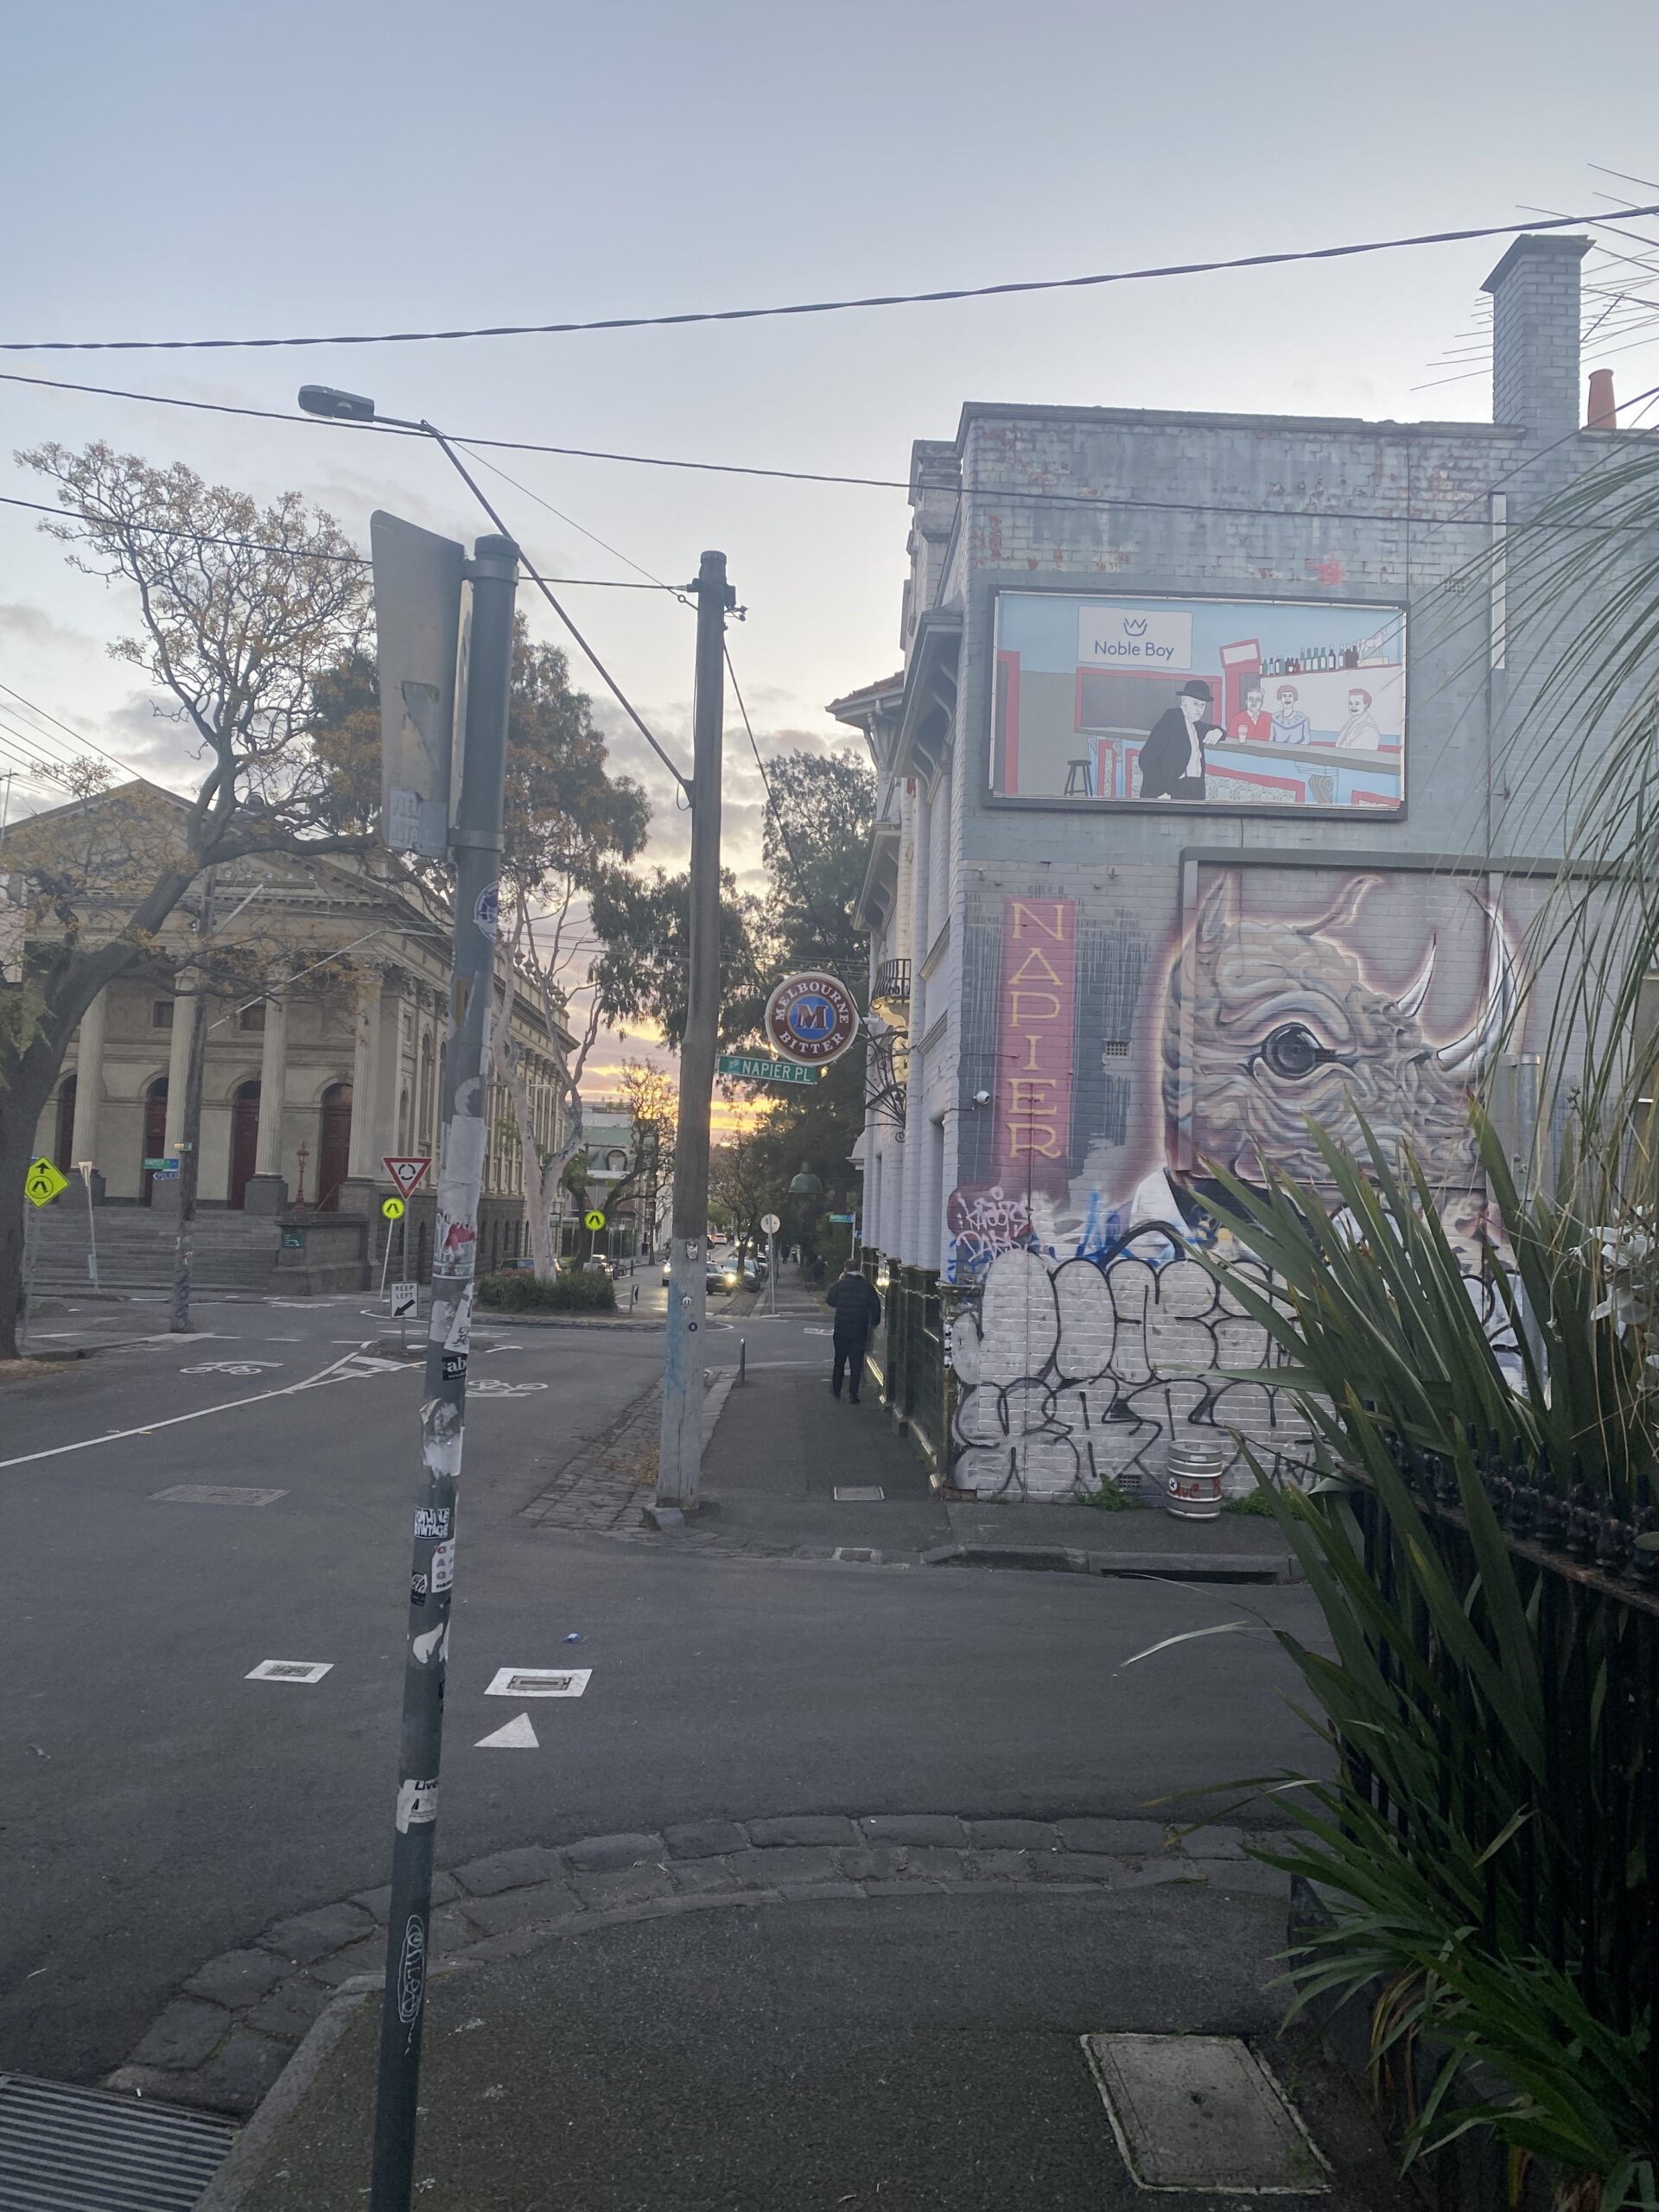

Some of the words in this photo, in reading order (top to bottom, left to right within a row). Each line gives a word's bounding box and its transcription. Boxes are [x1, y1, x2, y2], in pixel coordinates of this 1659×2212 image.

[1094, 640, 1141, 656] Noble
[1145, 642, 1175, 661] Boy
[775, 982, 849, 1024] MELBOURNE
[794, 1004, 829, 1030] M
[779, 1031, 844, 1054] BITTER
[1008, 902, 1065, 1159] NAPIER
[742, 1060, 791, 1080] NAPIER
[794, 1066, 811, 1082] PL
